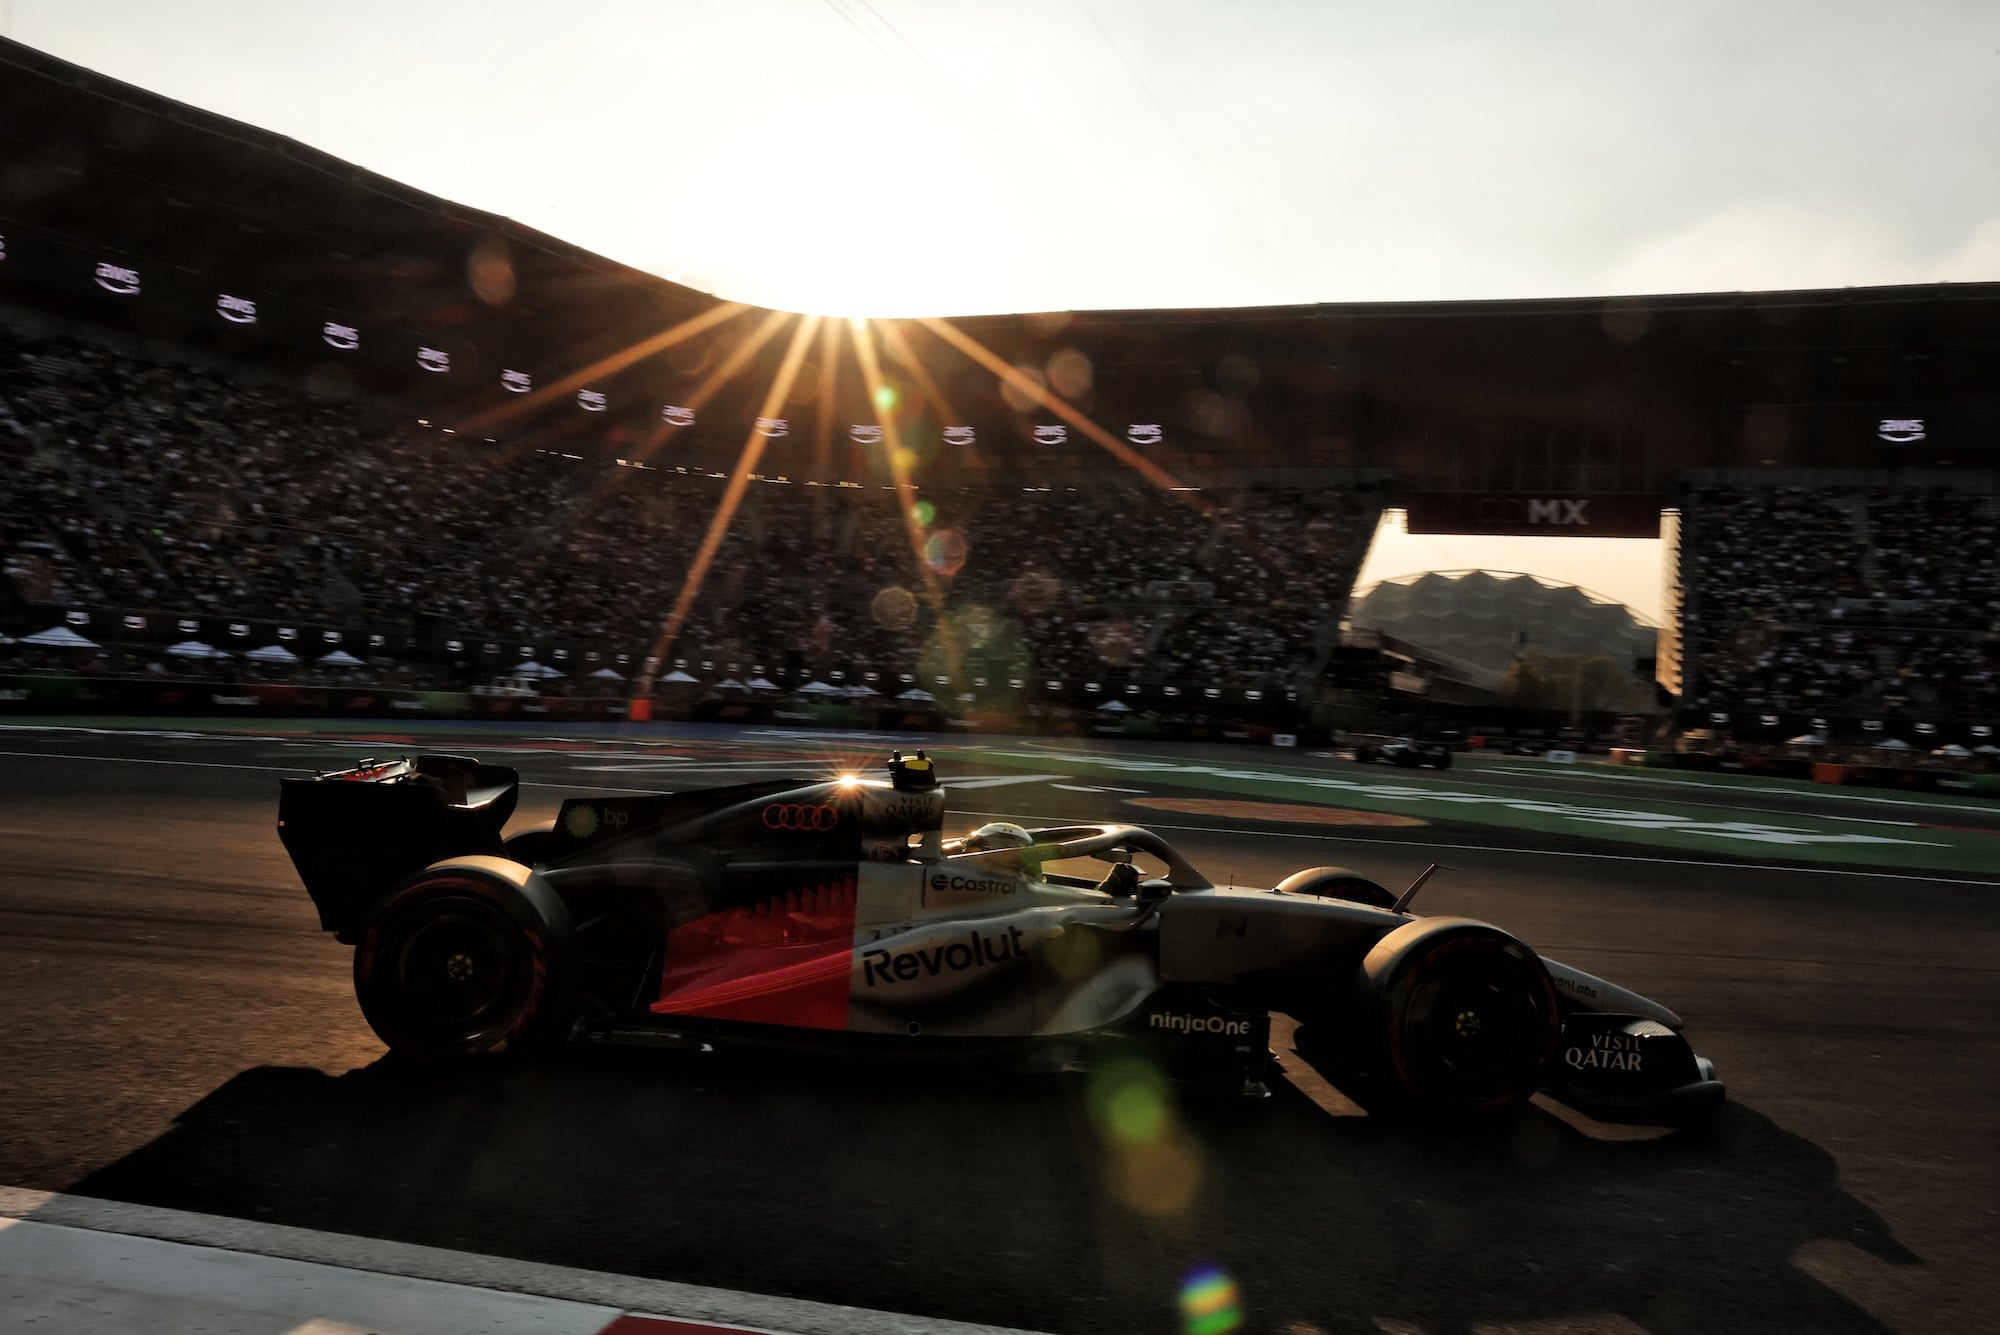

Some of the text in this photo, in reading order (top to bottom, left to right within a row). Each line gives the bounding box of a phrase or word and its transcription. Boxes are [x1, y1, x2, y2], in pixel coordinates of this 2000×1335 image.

[96, 262, 140, 285] aws
[217, 293, 257, 316] aws
[603, 807, 629, 830] bp
[951, 876, 1017, 896] Castrol
[863, 925, 1026, 987] Revolut
[1149, 1011, 1252, 1035] ninjaOne
[1564, 1046, 1643, 1072] QATAR
